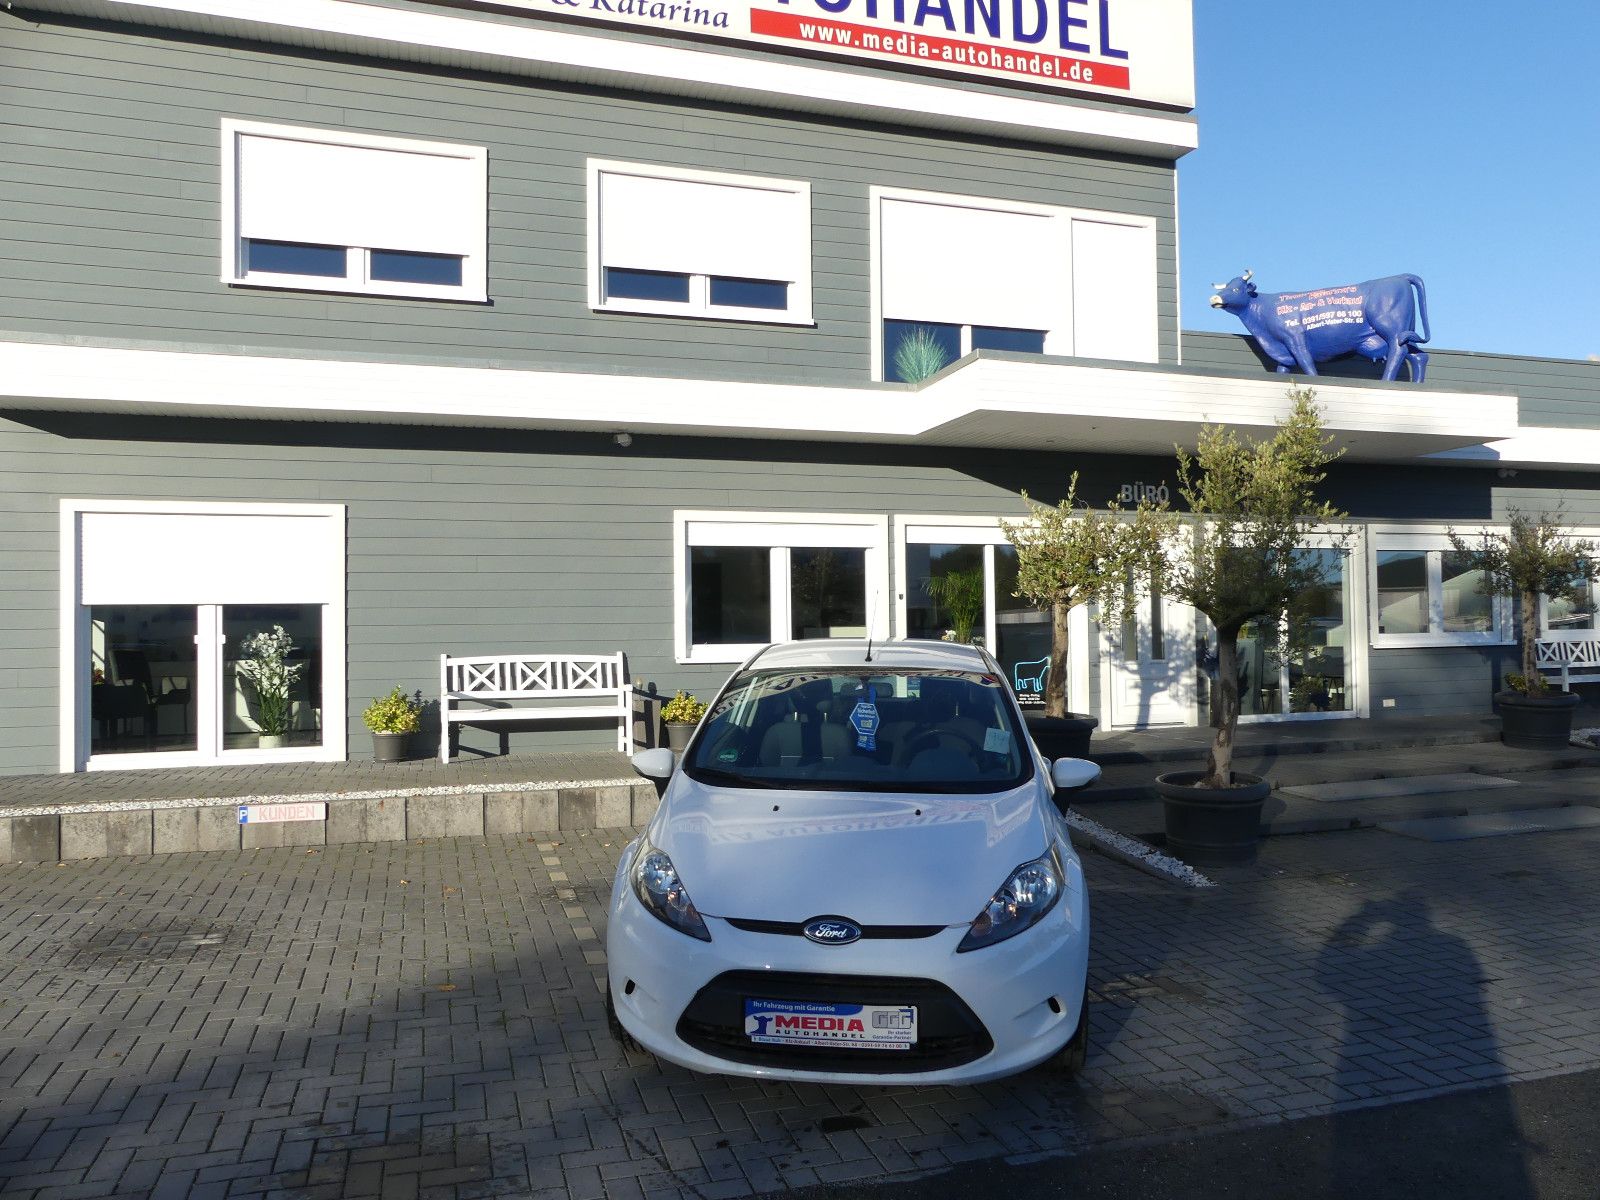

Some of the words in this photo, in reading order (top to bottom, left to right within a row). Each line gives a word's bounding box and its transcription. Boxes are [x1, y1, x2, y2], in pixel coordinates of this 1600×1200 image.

[778, 0, 1129, 60] ANDEL
[800, 23, 1093, 82] www.media-autohandel.de
[1285, 319, 1300, 327] Tel.
[1121, 481, 1169, 503] BÜRO
[259, 806, 315, 820] KUNDEN
[815, 923, 847, 938] Ford
[764, 1001, 793, 1011] Fahrzeug
[775, 1014, 865, 1032] MEDIA
[775, 1029, 865, 1038] AUTOHANDEL
